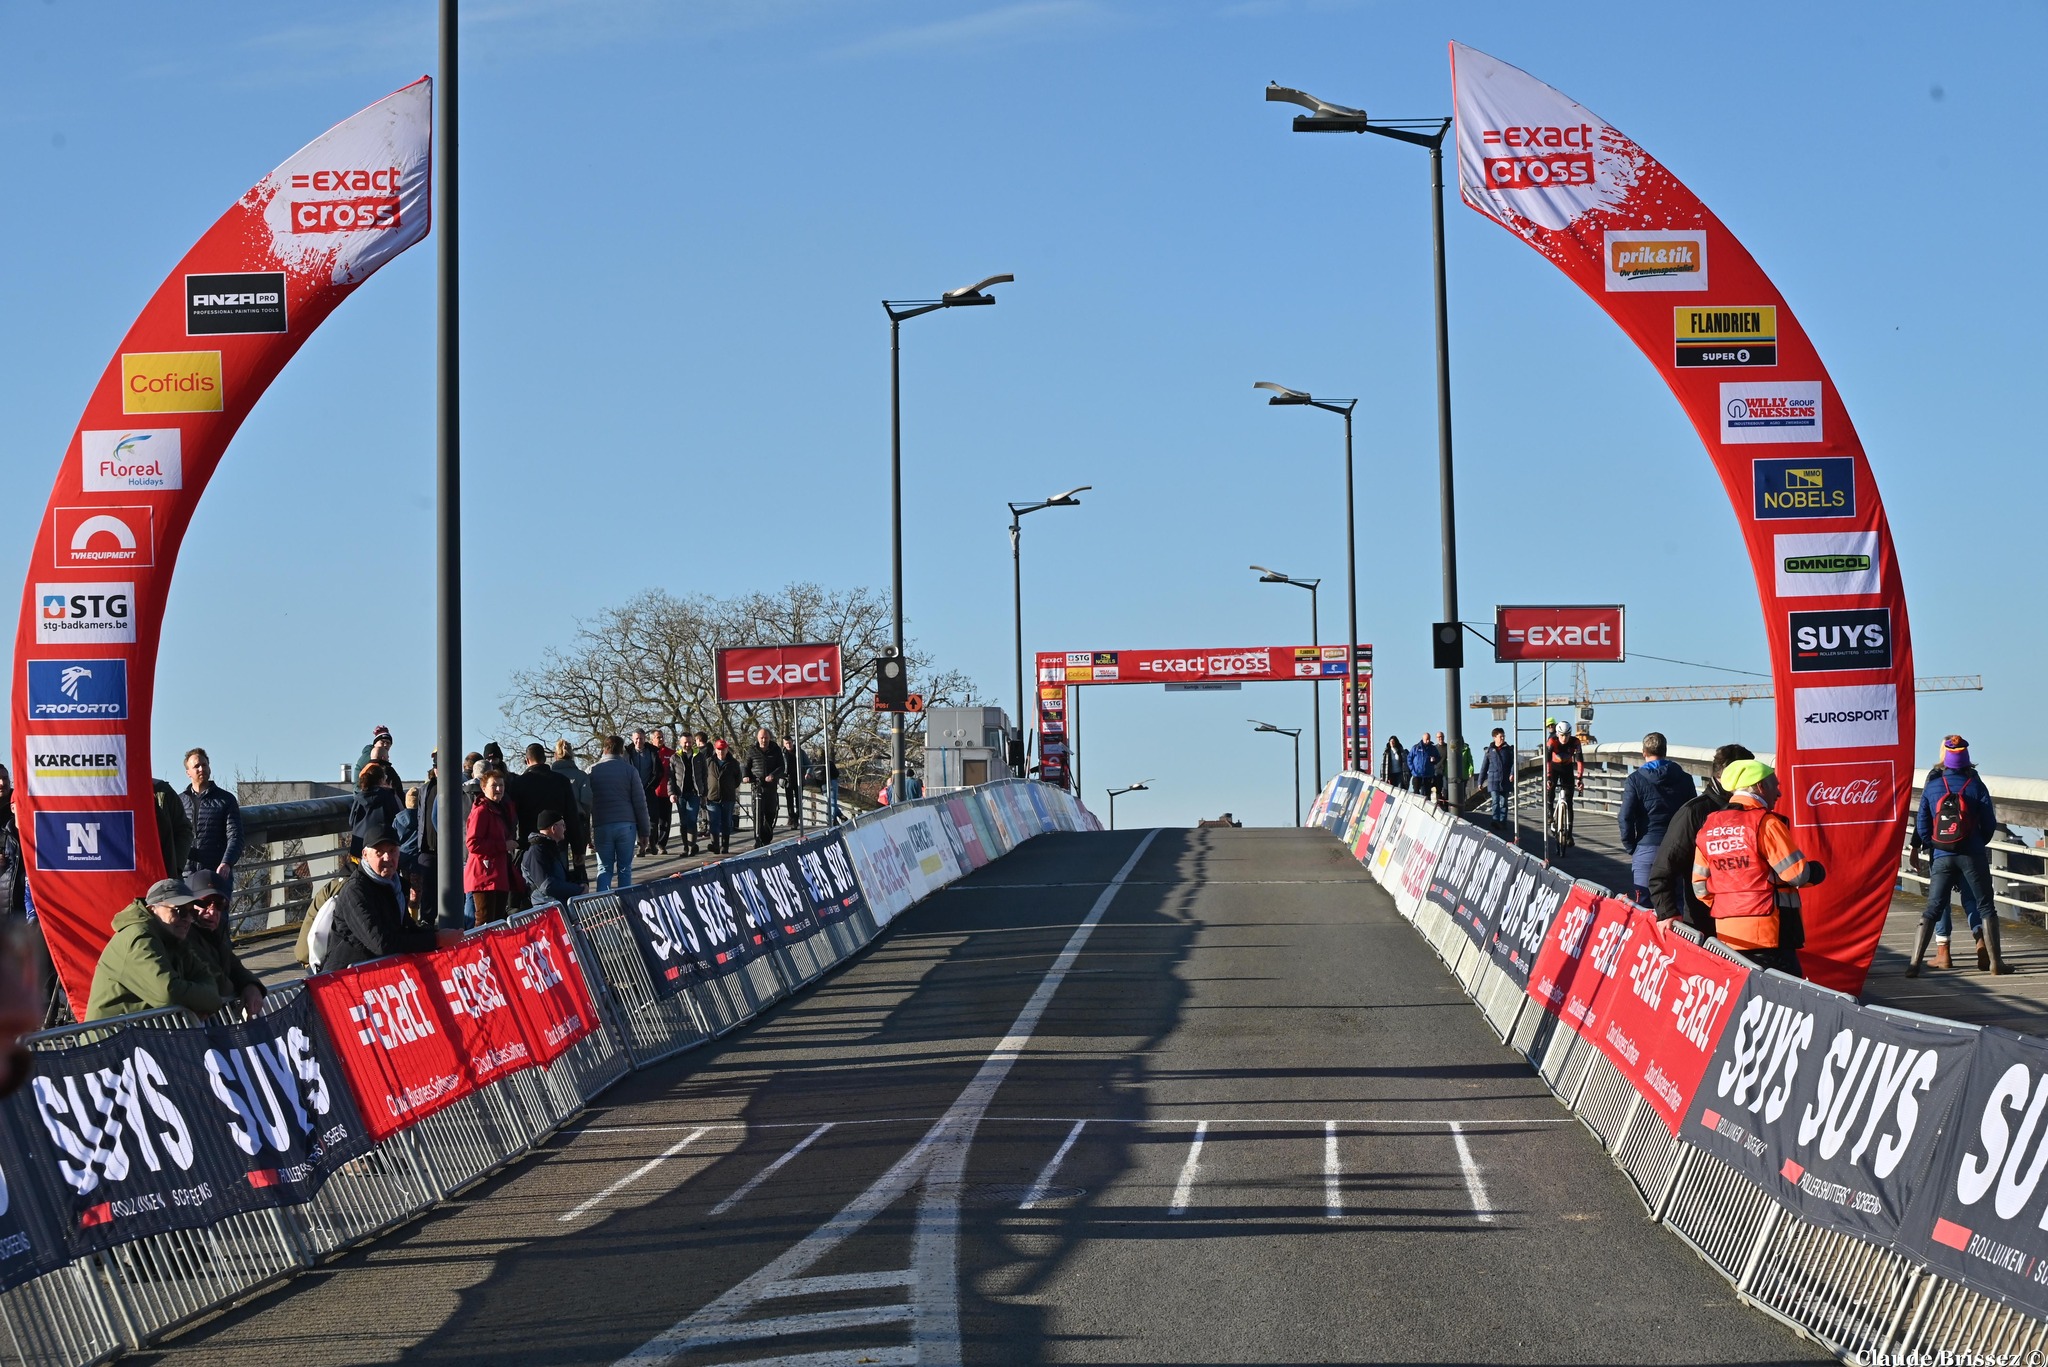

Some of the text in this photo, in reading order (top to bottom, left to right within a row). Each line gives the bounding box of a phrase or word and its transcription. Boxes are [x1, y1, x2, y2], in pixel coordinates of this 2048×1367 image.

[1491, 160, 1589, 184] cross
[298, 204, 394, 227] cross
[193, 293, 275, 306] ANZA PRO
[1691, 312, 1760, 334] FLANDRIEN
[1702, 351, 1748, 362] SUPER 8
[130, 372, 215, 393] Cofidis
[1745, 398, 1815, 408] WILLY GROUP
[1748, 407, 1815, 418] NAESSENS
[100, 460, 163, 477] Floreal
[128, 478, 164, 487] Holidays
[1764, 491, 1845, 509] NOBELS
[1787, 557, 1867, 570] OMNICOL
[70, 594, 128, 618] STG
[43, 619, 128, 632] stg-badkamers.be
[1797, 623, 1884, 651] SUYS
[1211, 657, 1268, 671] cross
[35, 703, 120, 714] PROFORTO
[1805, 709, 1889, 724] EUROSPORT
[34, 753, 118, 767] KÄRCHER
[1806, 779, 1881, 807] Coca-Cola
[66, 823, 100, 854] N
[1709, 840, 1744, 851] cross
[1713, 855, 1750, 871] CREW
[732, 868, 771, 928] SUYS
[761, 863, 803, 920] SUYS
[638, 890, 700, 961] SUYS
[1718, 994, 1814, 1125] SUYS
[204, 1026, 330, 1155] SUYS
[1797, 1027, 1938, 1179] SUYS
[32, 1046, 194, 1196] SUYS
[171, 1182, 213, 1207] SCREENS
[1818, 1180, 1852, 1205] SHUTTERS
[1850, 1191, 1882, 1215] SCREENS
[1967, 1233, 2027, 1274] ROLLUIKEN
